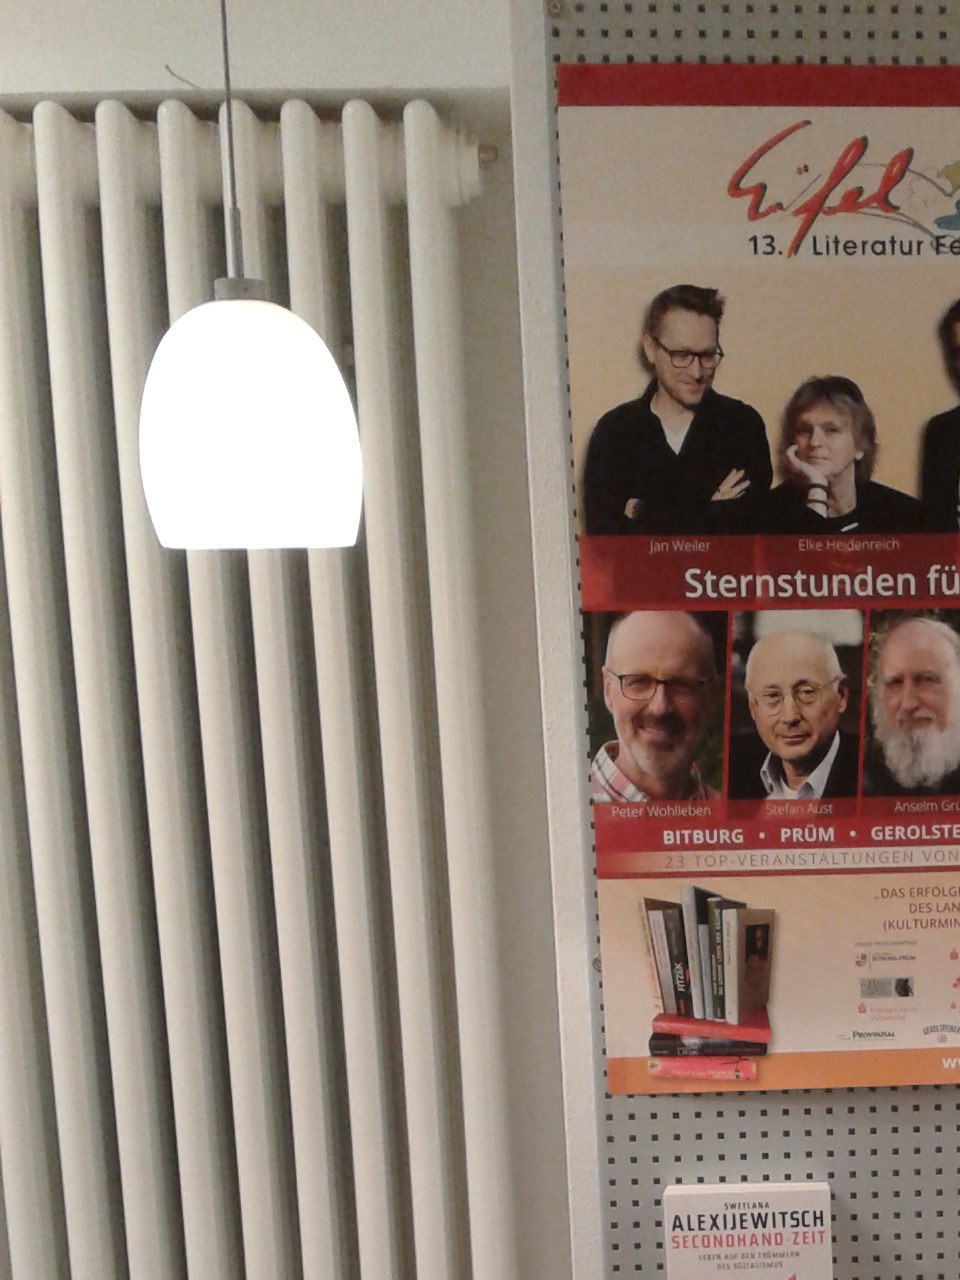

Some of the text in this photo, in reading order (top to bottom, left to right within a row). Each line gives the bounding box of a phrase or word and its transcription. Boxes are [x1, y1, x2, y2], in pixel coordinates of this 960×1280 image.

[748, 236, 783, 256] 13.
[812, 236, 923, 256] Literatur
[649, 540, 710, 553] Jan Weiler
[798, 538, 900, 551] Elke Heidenreich
[684, 566, 915, 598] Sternstunden
[612, 804, 711, 817] Peter Wohlleben
[766, 803, 833, 816] Stefan Aust
[895, 799, 939, 813] Anselm
[663, 829, 744, 844] BITBURG
[780, 825, 835, 842] PRÜM
[693, 851, 913, 868] TOP-VERANSTALTUNGEN
[924, 849, 959, 863] VON
[909, 901, 933, 914] DES
[672, 1210, 824, 1232] ALEXIJEWITSCH
